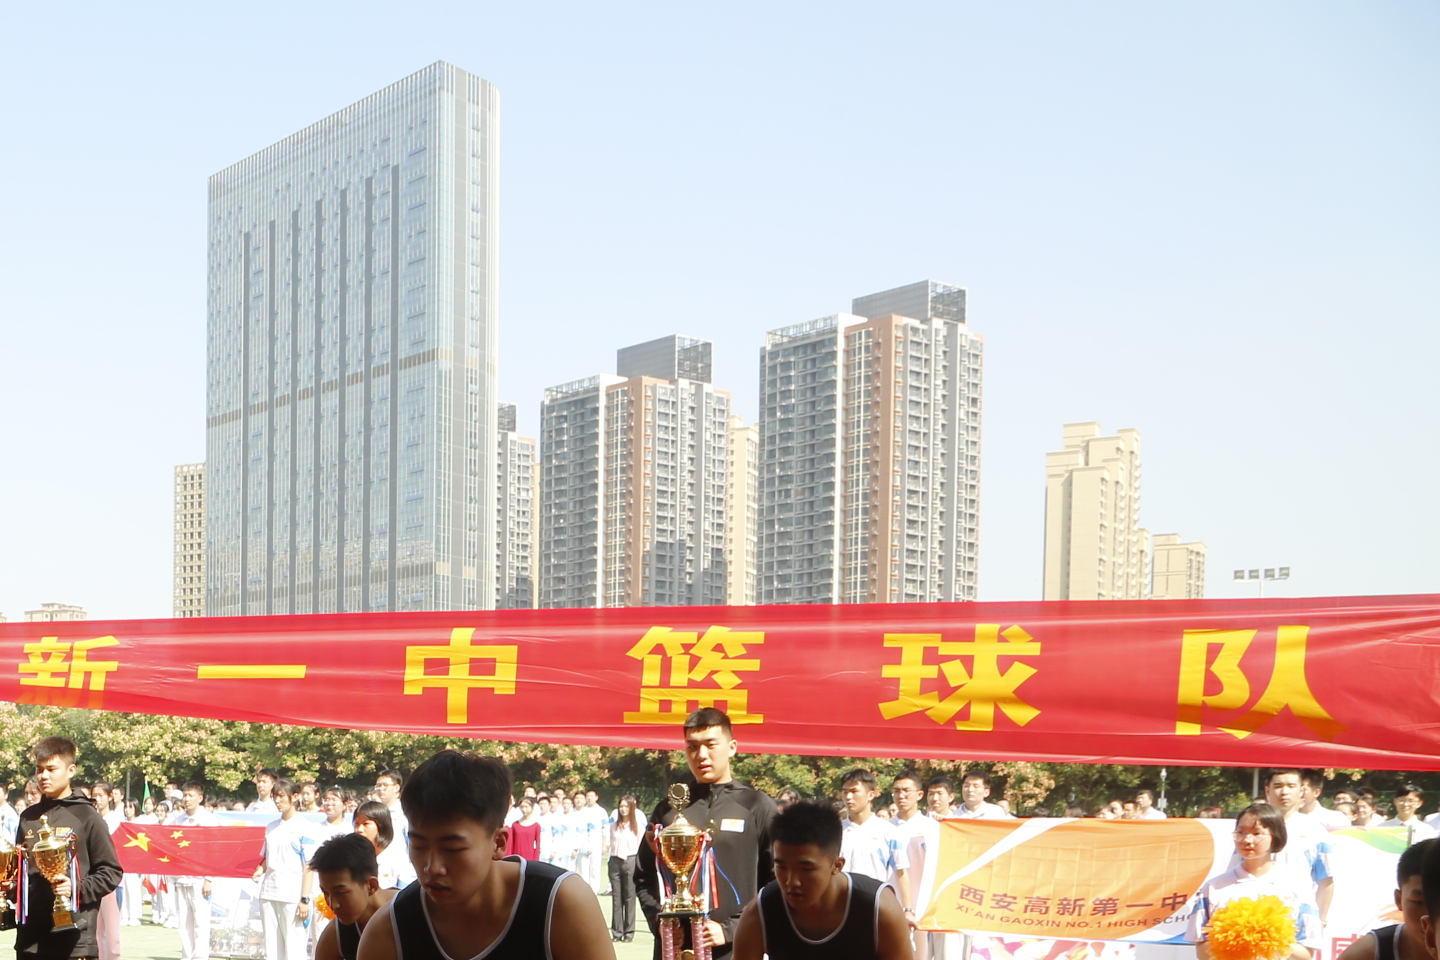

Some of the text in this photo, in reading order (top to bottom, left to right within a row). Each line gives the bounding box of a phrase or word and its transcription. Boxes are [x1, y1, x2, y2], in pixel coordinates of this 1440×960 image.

[959, 883, 1202, 917] 西安高新第一中
[999, 915, 1060, 928] GAOXIN
[1065, 919, 1102, 929] NO.1
[1107, 918, 1147, 928] HIGH
